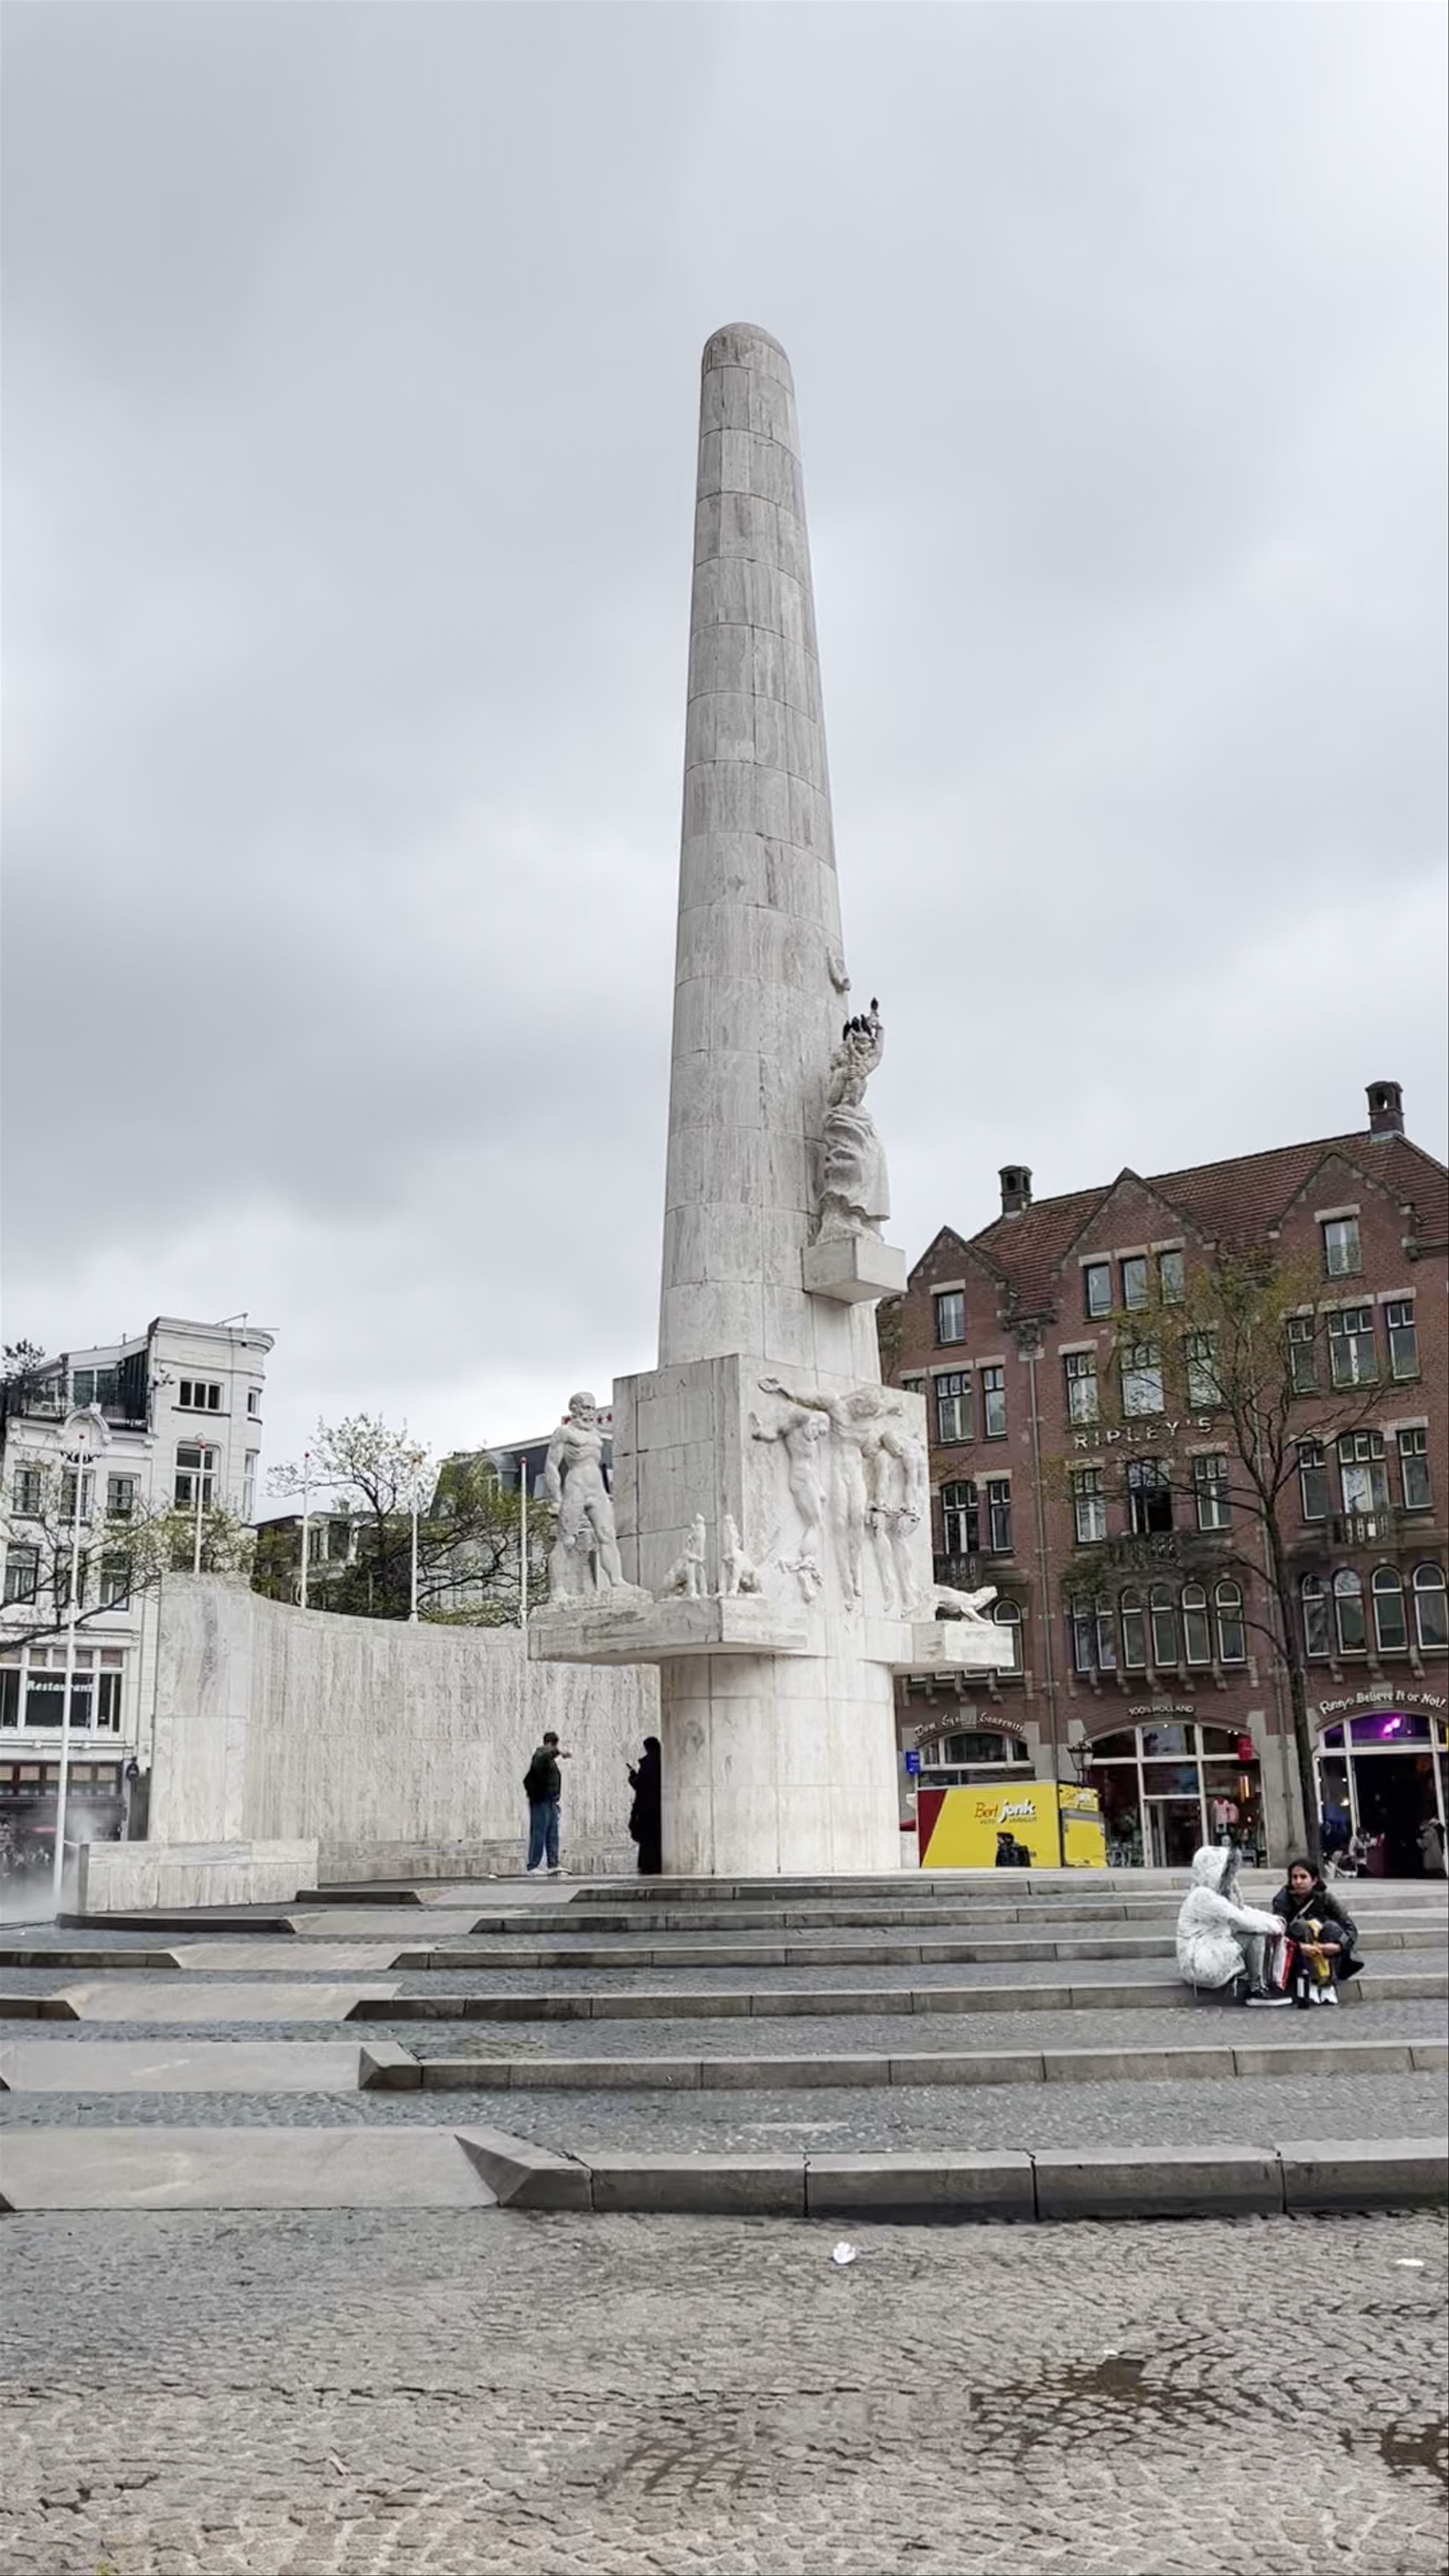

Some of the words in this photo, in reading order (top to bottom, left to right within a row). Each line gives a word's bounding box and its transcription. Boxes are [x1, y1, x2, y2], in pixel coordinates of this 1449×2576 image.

[1074, 1417, 1212, 1449] RIPLEY'S
[27, 1680, 93, 1692] Restauant
[1395, 1689, 1405, 1701] It
[1407, 1693, 1420, 1701] or
[1420, 1693, 1446, 1708] Not!
